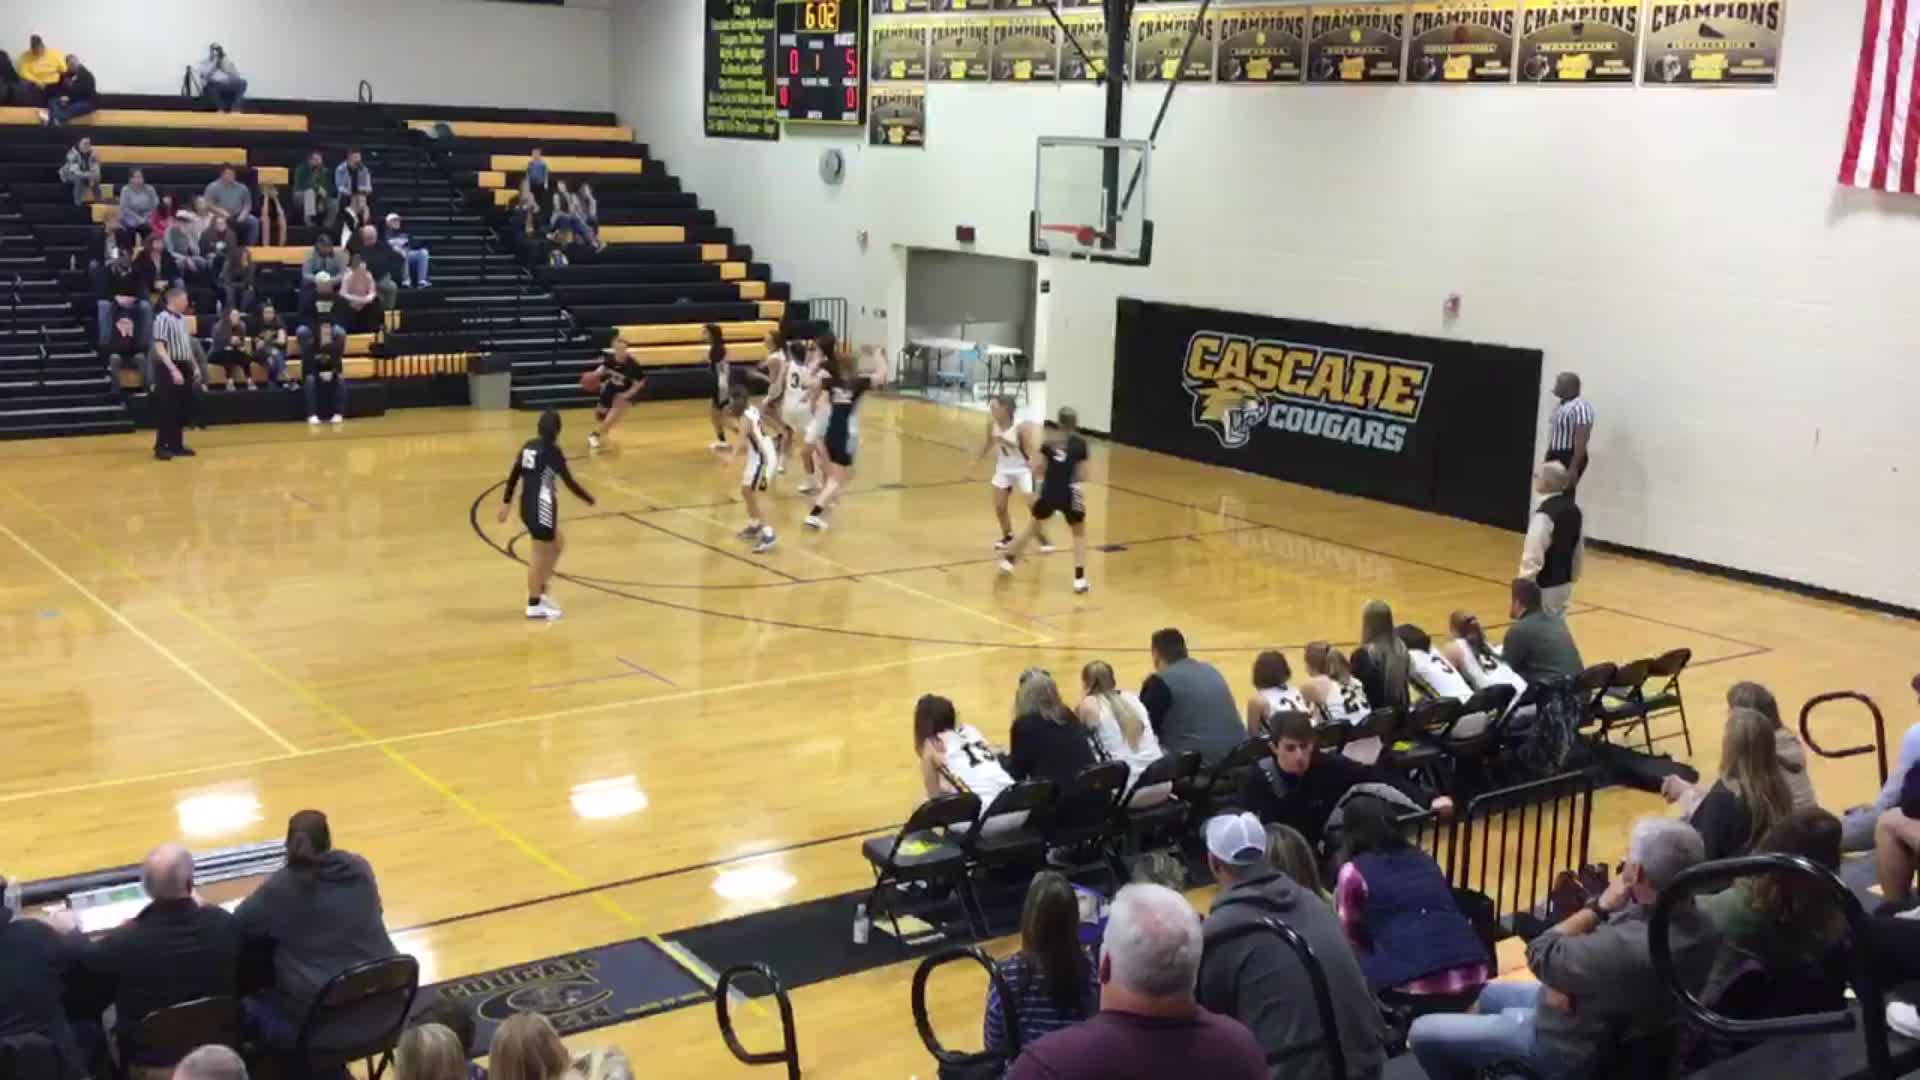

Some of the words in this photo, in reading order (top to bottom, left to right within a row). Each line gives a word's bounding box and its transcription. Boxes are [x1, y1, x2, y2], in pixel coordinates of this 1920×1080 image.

[1221, 16, 1304, 40] CHAMPIONS
[1312, 13, 1403, 39] CHAMPIONS
[1413, 10, 1513, 36] CHAMPIONS
[1524, 6, 1637, 34] CHAMPIONS
[1652, 2, 1779, 32] CHAMPIONS
[931, 26, 988, 46] CHAMPIONS
[994, 24, 1056, 45] CHAMPIONS
[789, 49, 799, 75] 0
[845, 49, 857, 75] 5
[1186, 335, 1428, 417] CASCADE
[1268, 404, 1407, 451] COUGARS
[439, 959, 600, 998] COUGAR
